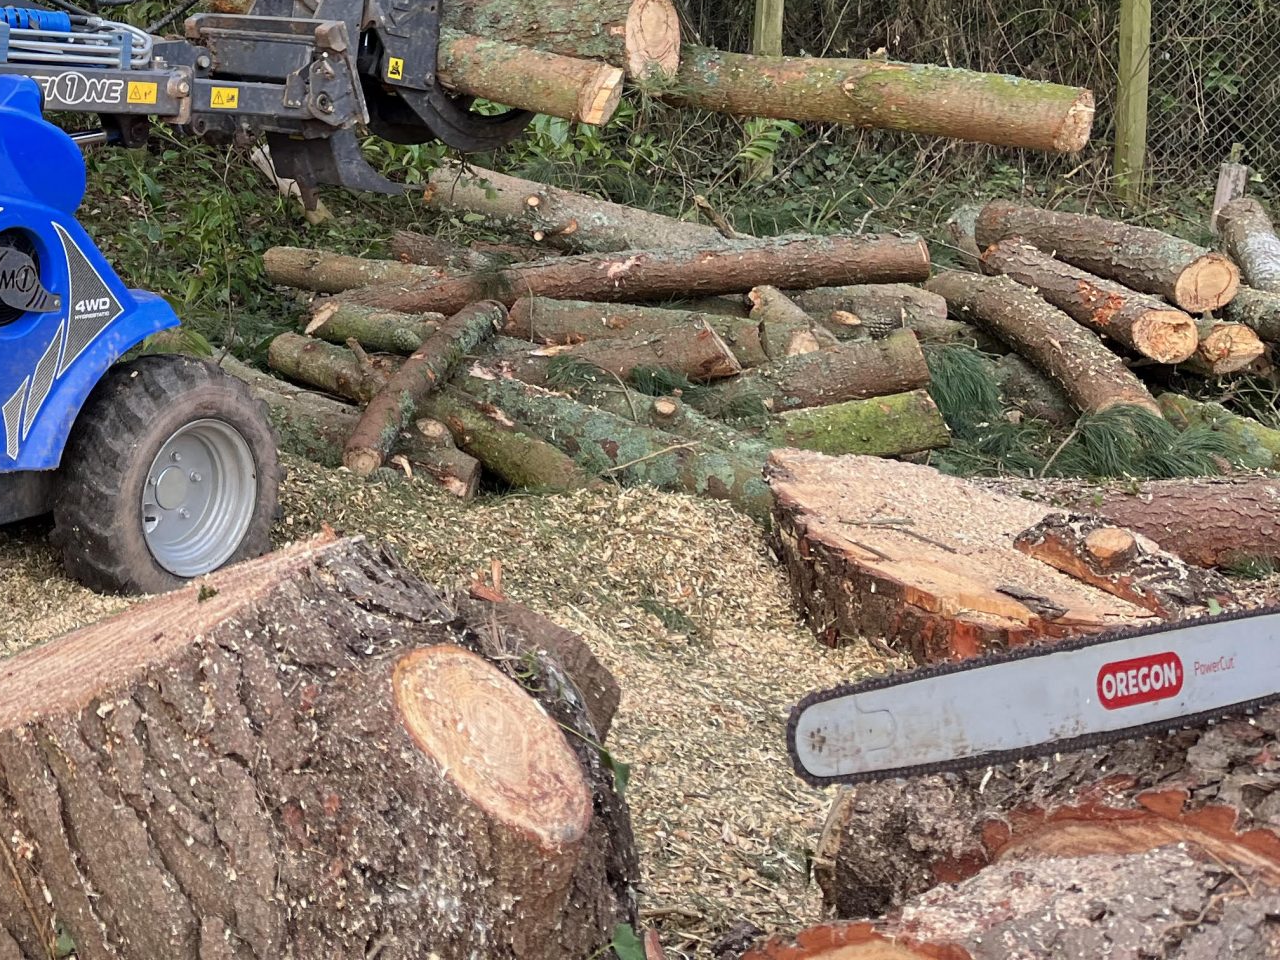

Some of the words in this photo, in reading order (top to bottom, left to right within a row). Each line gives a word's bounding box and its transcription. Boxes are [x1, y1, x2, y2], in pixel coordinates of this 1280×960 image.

[75, 297, 110, 312] 4WD
[1102, 662, 1177, 700] OREGON
[1194, 656, 1235, 676] PowerCut
